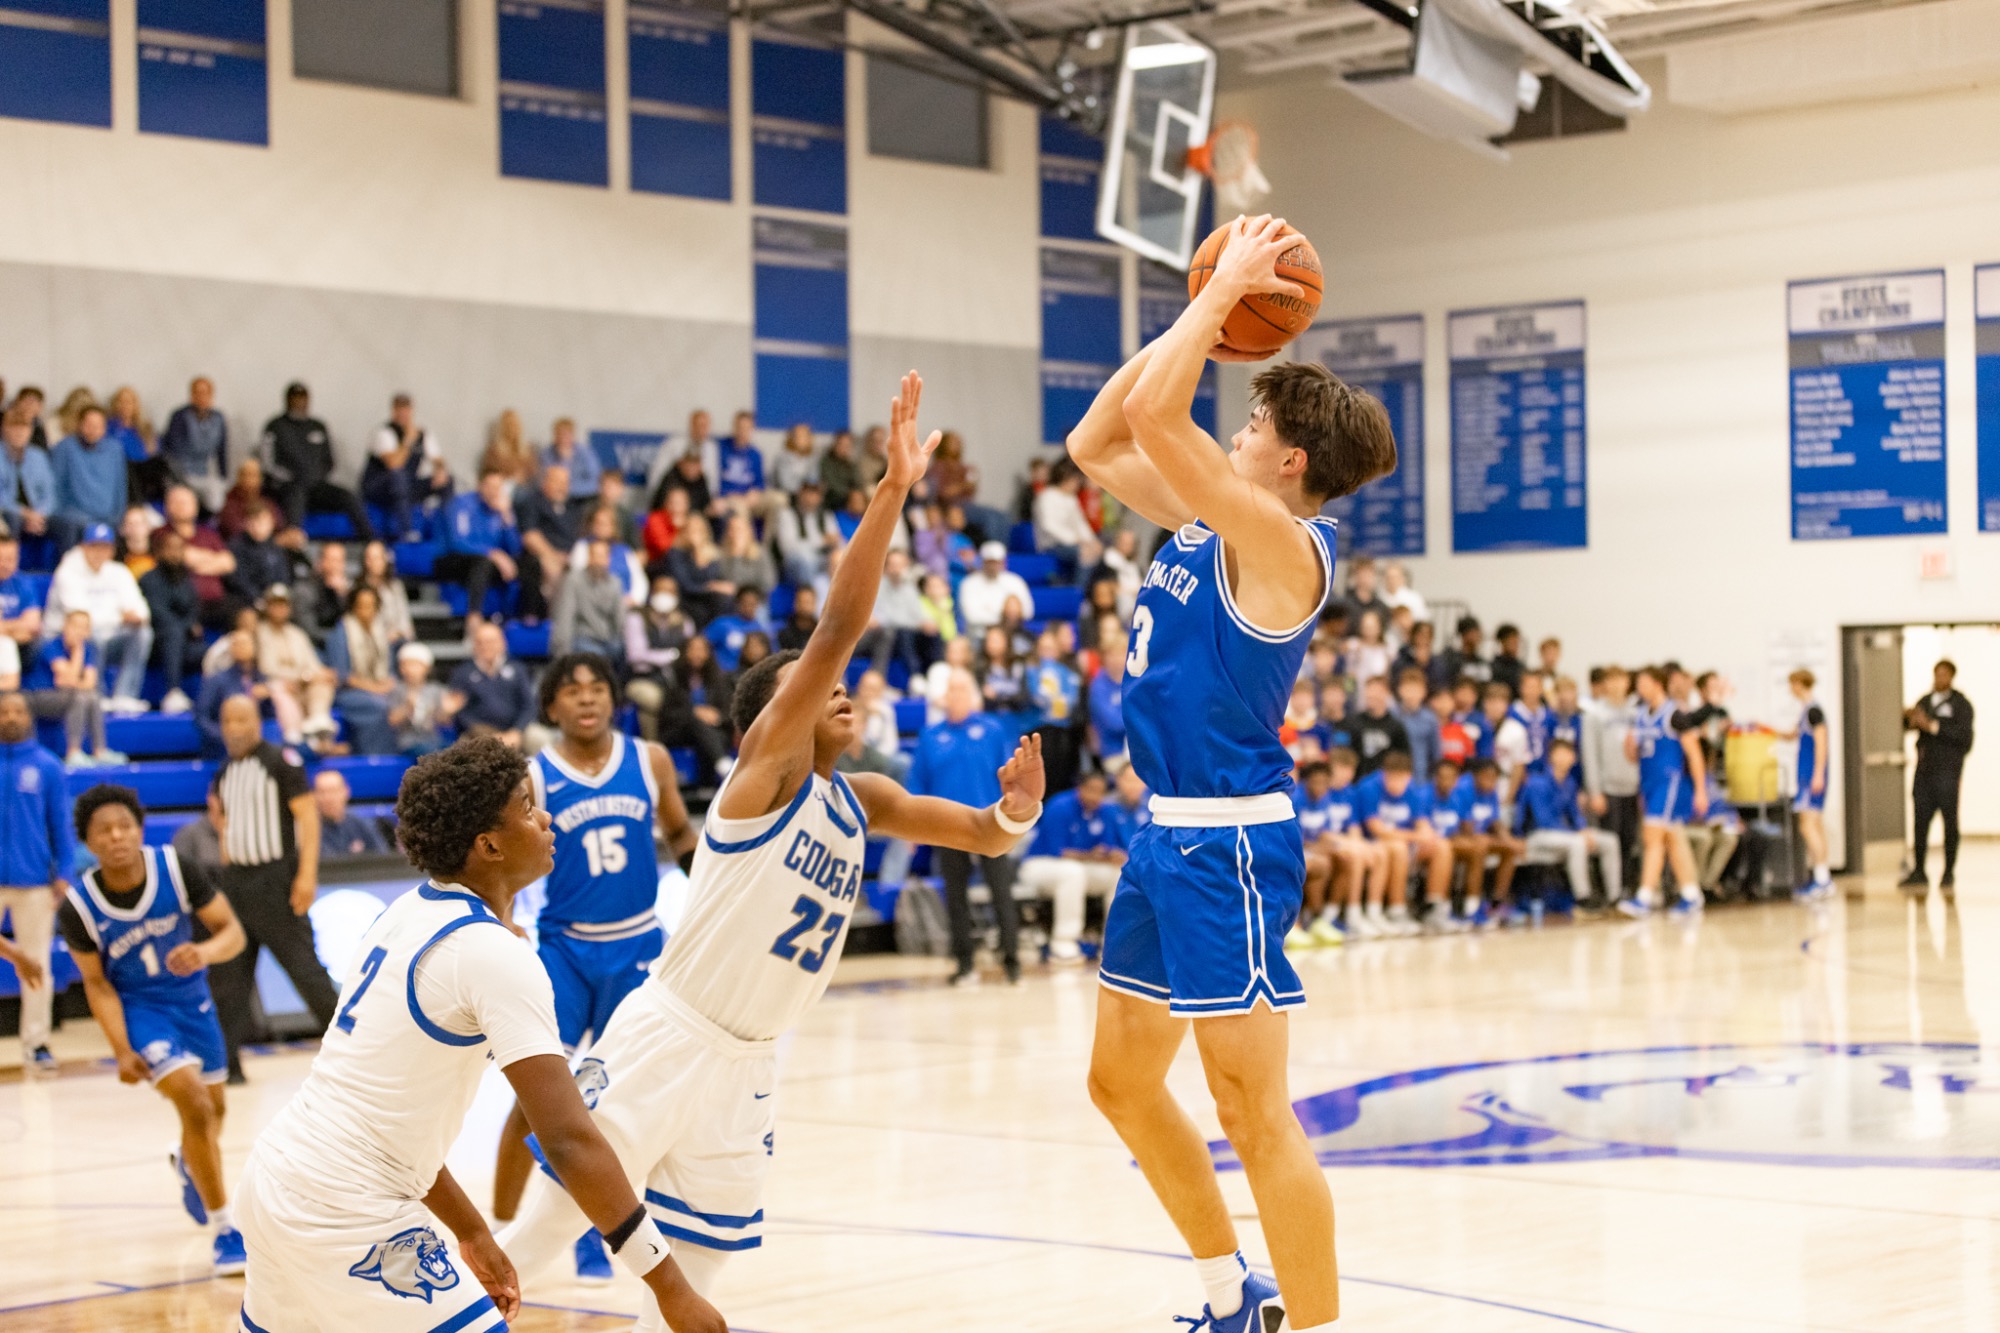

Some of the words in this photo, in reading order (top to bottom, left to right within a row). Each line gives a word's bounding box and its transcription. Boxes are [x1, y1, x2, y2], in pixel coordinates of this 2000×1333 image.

[1126, 604, 1154, 677] 3
[582, 824, 628, 877] 15
[140, 943, 160, 977] 1
[769, 893, 846, 974] 23
[336, 945, 388, 1036] 2
